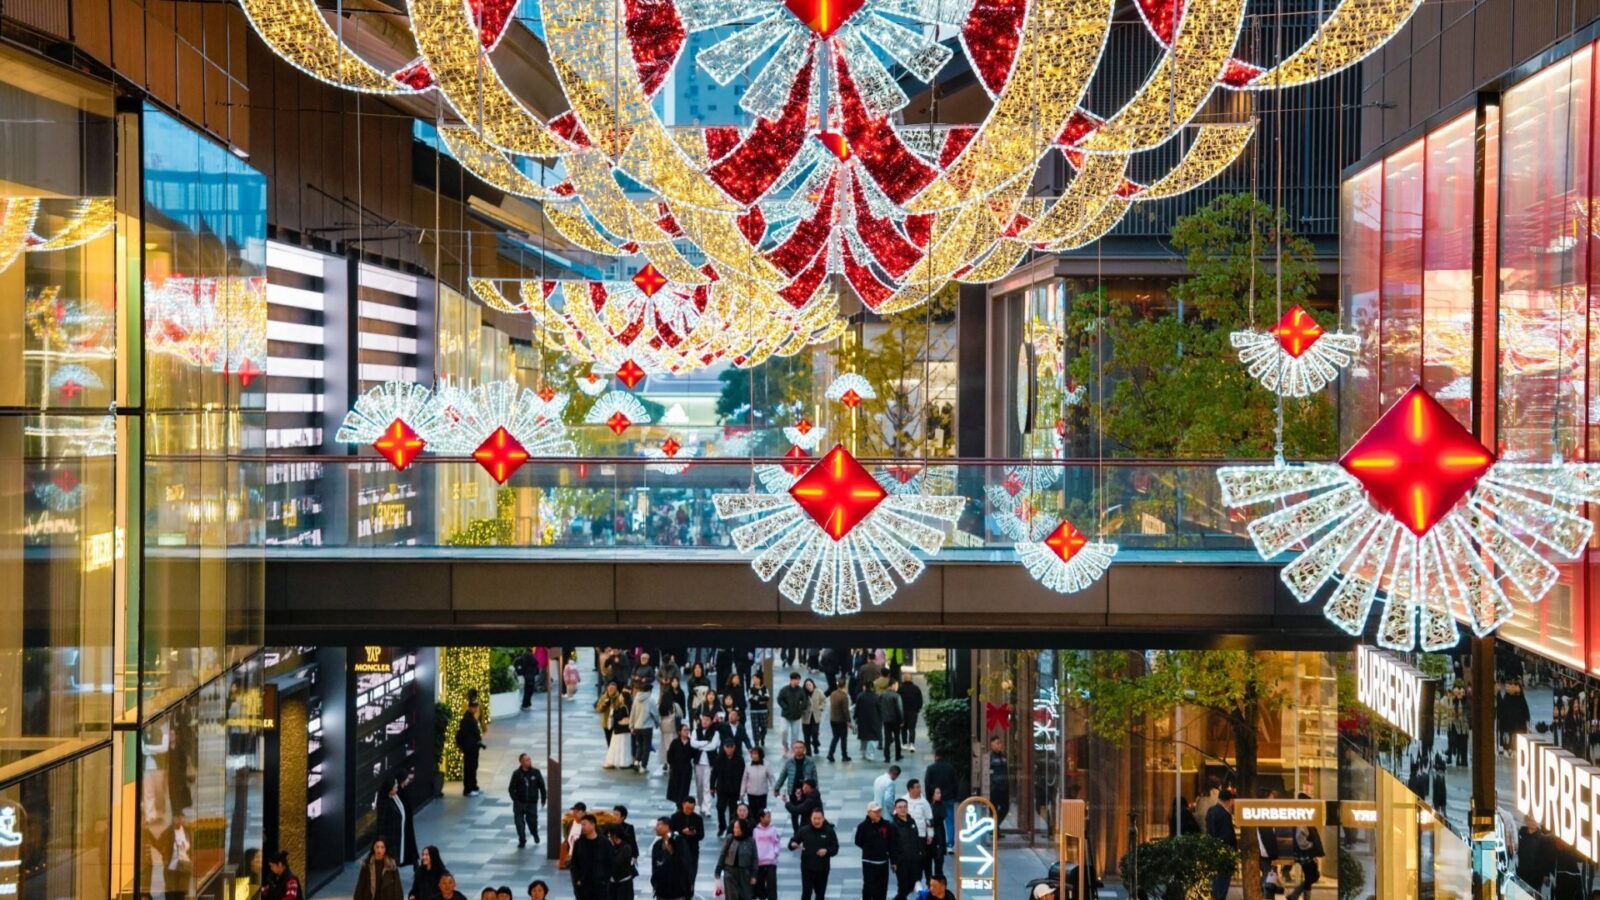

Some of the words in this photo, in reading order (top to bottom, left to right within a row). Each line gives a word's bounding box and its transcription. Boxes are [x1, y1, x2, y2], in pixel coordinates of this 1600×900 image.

[354, 663, 391, 672] MONCLER
[1357, 644, 1421, 741] BURBERRY
[1242, 808, 1315, 820] BURBERRY
